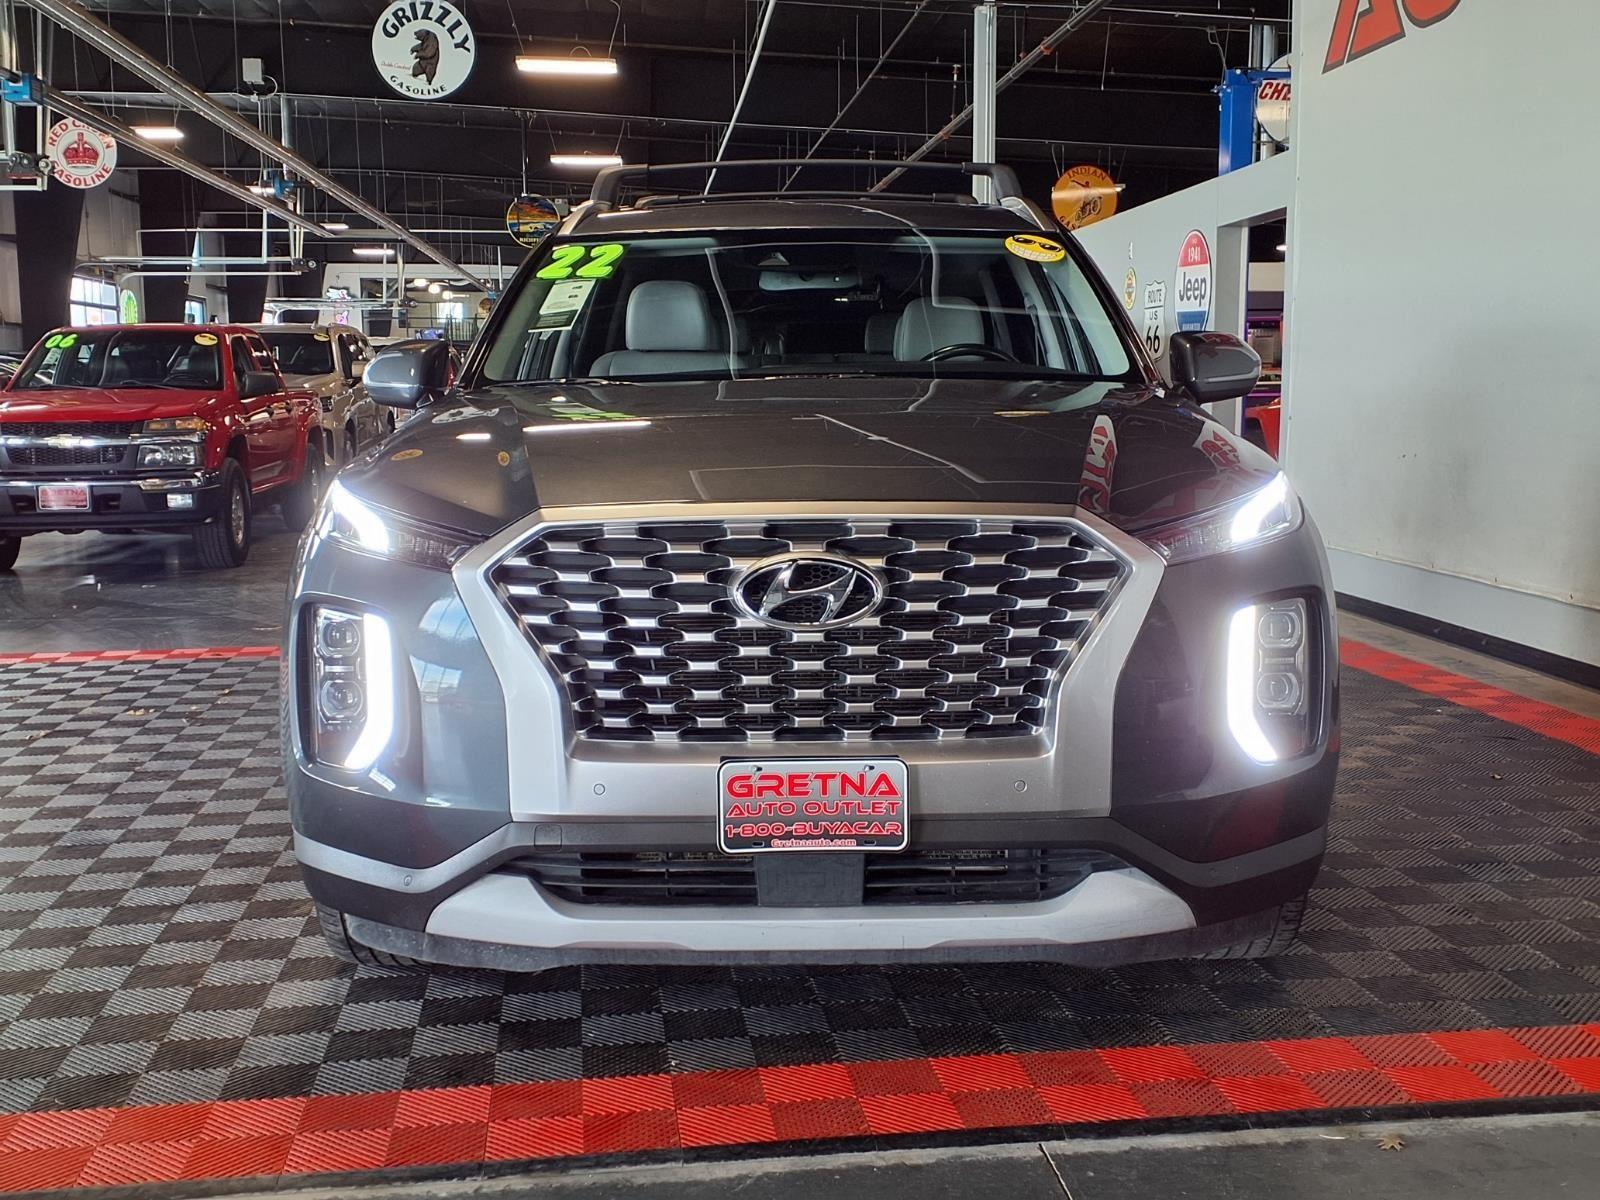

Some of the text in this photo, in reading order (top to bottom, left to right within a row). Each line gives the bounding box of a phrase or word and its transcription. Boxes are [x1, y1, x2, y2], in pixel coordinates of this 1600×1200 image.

[382, 1, 471, 53] GRIZZLY
[390, 75, 447, 95] GASOLINE
[48, 121, 69, 147] RED
[1067, 166, 1107, 181] INDIAN
[535, 243, 624, 280] 22
[1187, 246, 1201, 262] 1941
[1147, 288, 1162, 304] ROUTE
[1178, 271, 1207, 307] Jeep
[1149, 310, 1158, 321] US
[45, 333, 79, 349] 06
[1145, 324, 1160, 354] 66
[726, 771, 901, 799] GRETNA
[726, 800, 902, 818] AUTO OUTLET
[725, 821, 902, 838] 1-800-BUYACAR
[771, 838, 857, 848] Gretnaauto.com
